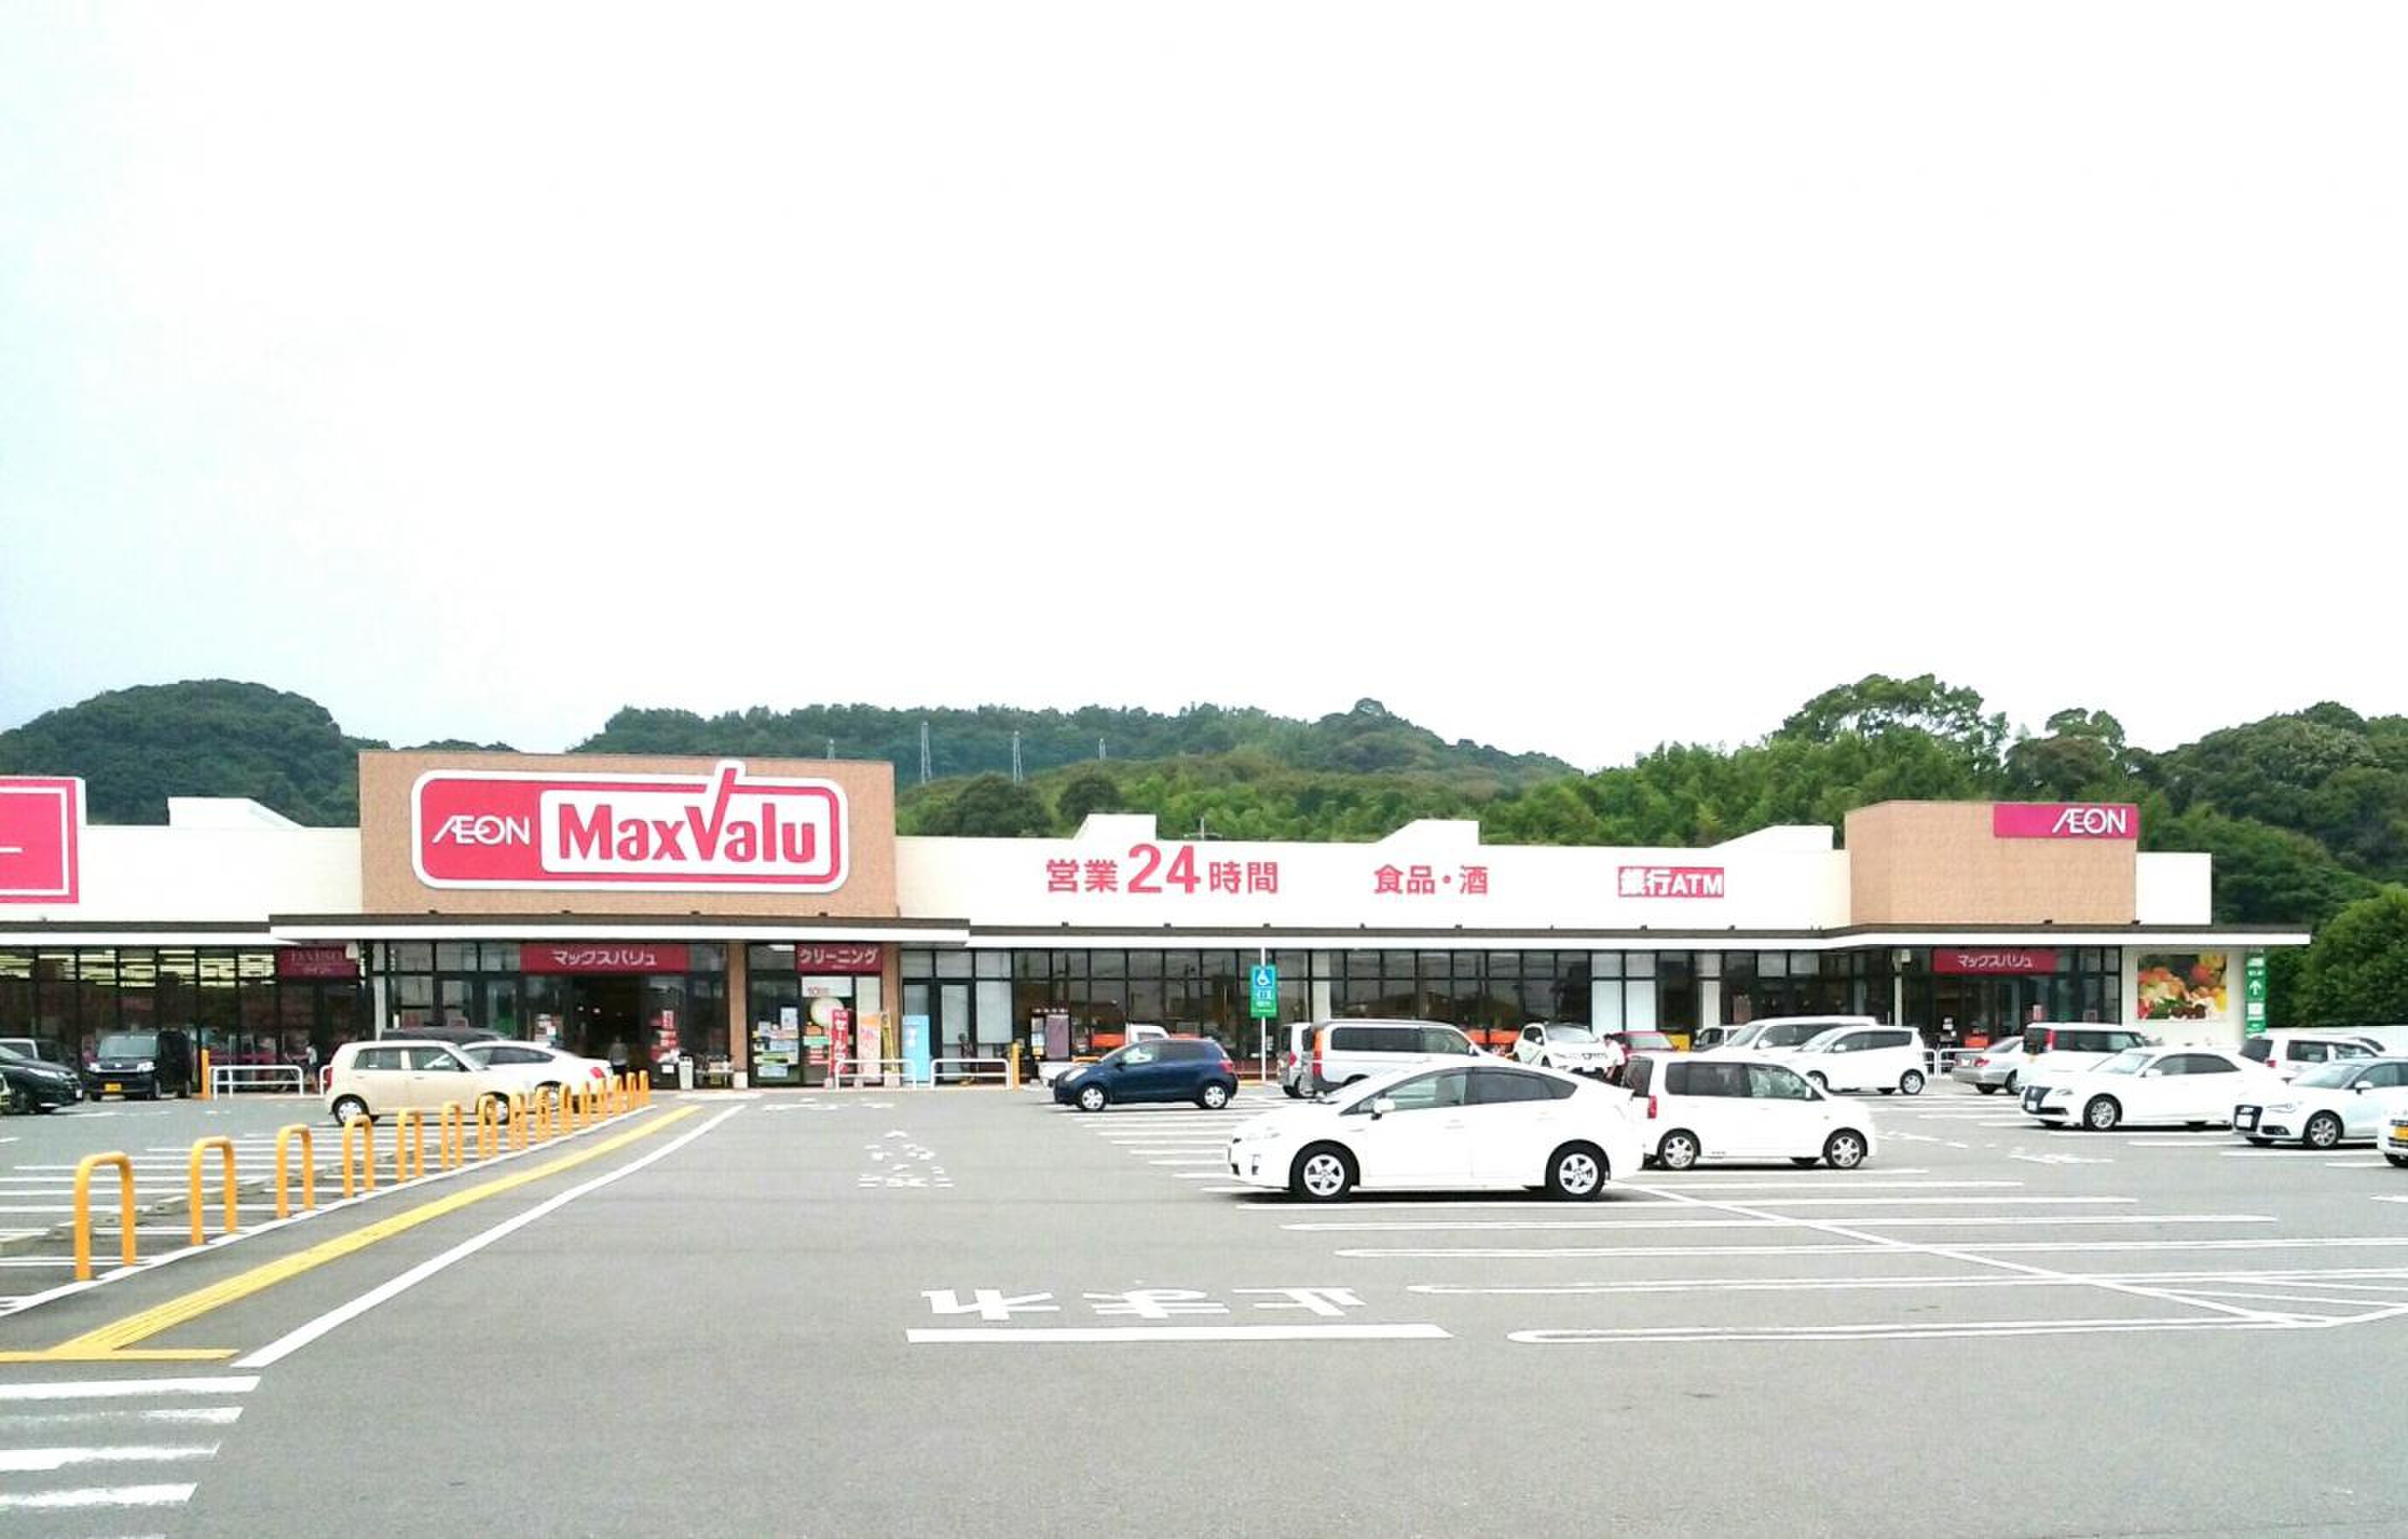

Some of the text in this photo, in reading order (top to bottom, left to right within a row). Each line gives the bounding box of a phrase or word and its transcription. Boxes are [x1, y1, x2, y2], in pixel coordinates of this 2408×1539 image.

[558, 768, 817, 864] MaxValu
[1046, 843, 1278, 894] 営業24時間
[1373, 864, 1490, 895] 食品・酒
[552, 949, 658, 966] マックスバリュ
[800, 947, 879, 964] クリーニング
[1956, 952, 2034, 968] マックスバリュ
[921, 1288, 1368, 1321] 止まれ
